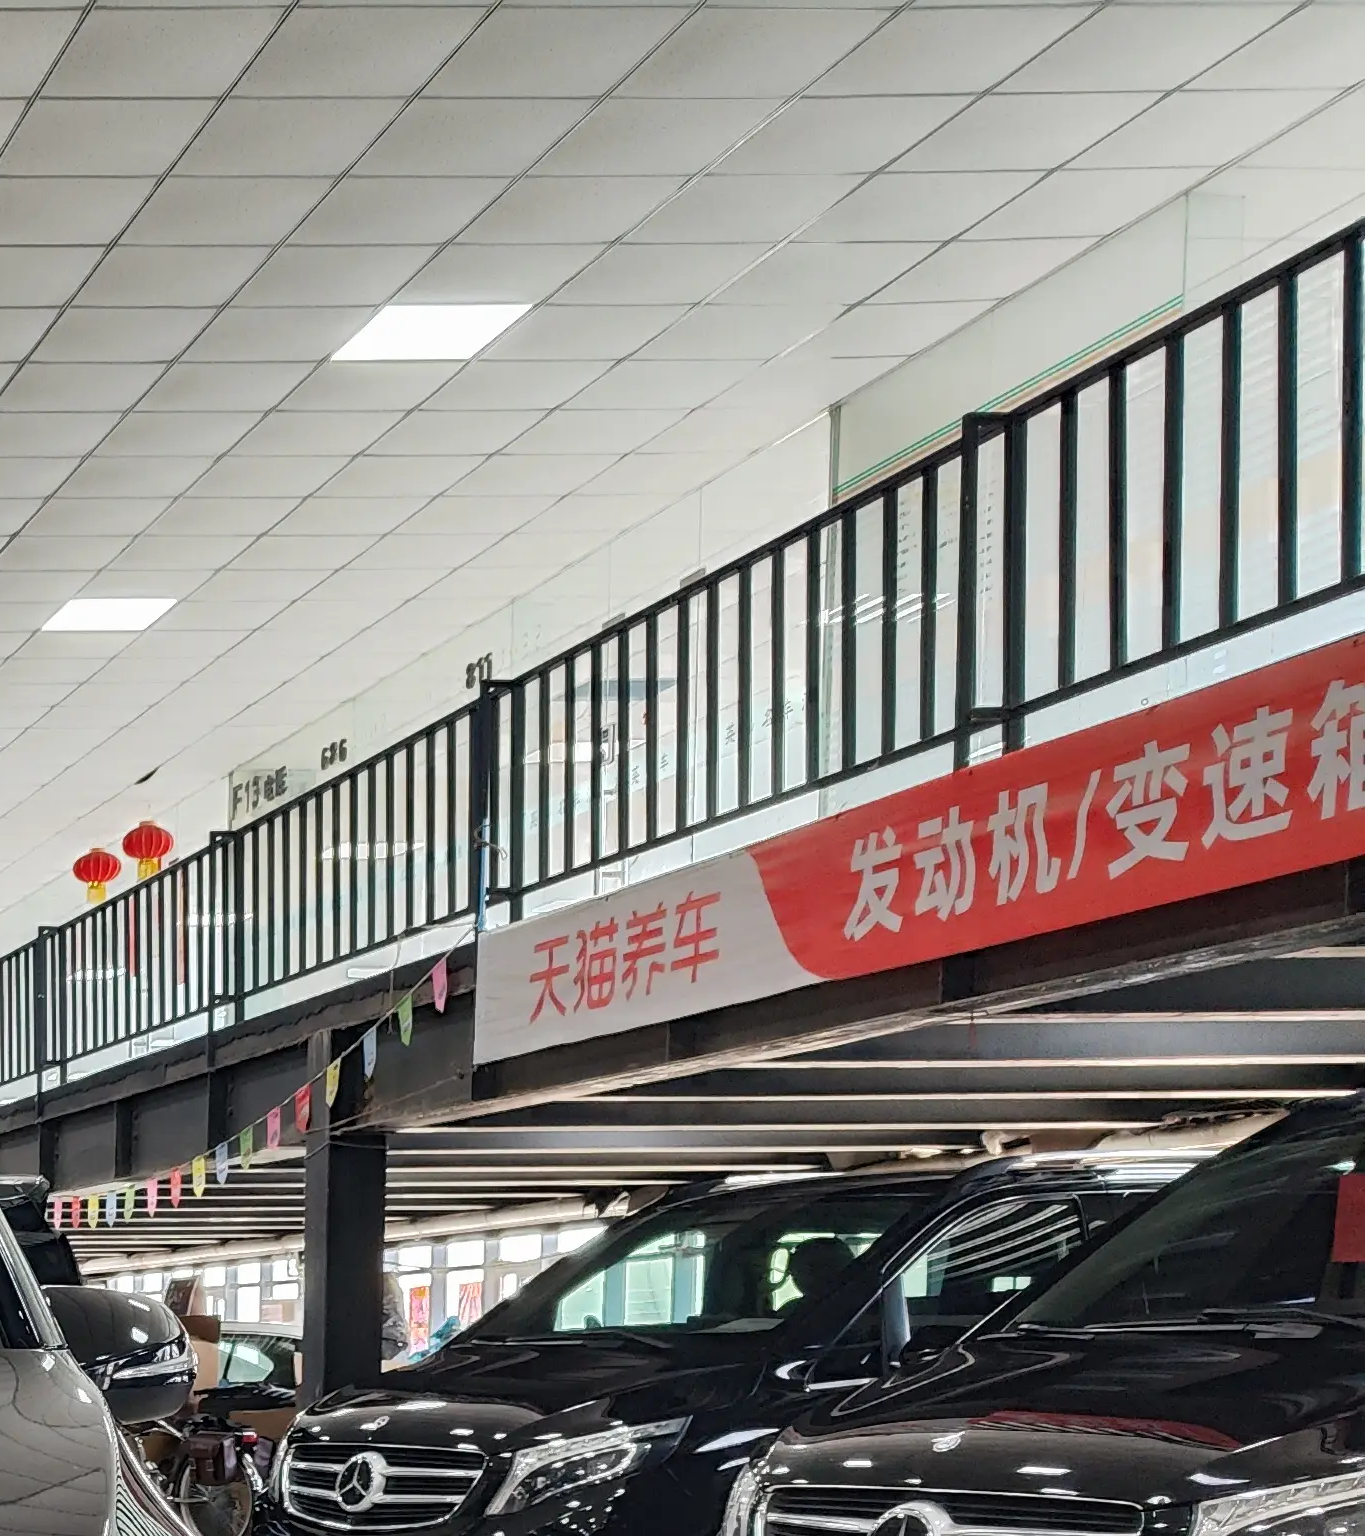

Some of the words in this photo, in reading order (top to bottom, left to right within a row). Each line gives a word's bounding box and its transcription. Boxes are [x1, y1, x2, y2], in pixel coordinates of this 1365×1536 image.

[844, 680, 1365, 941] 发动机/变速箱
[530, 891, 721, 1025] 天猫养车
